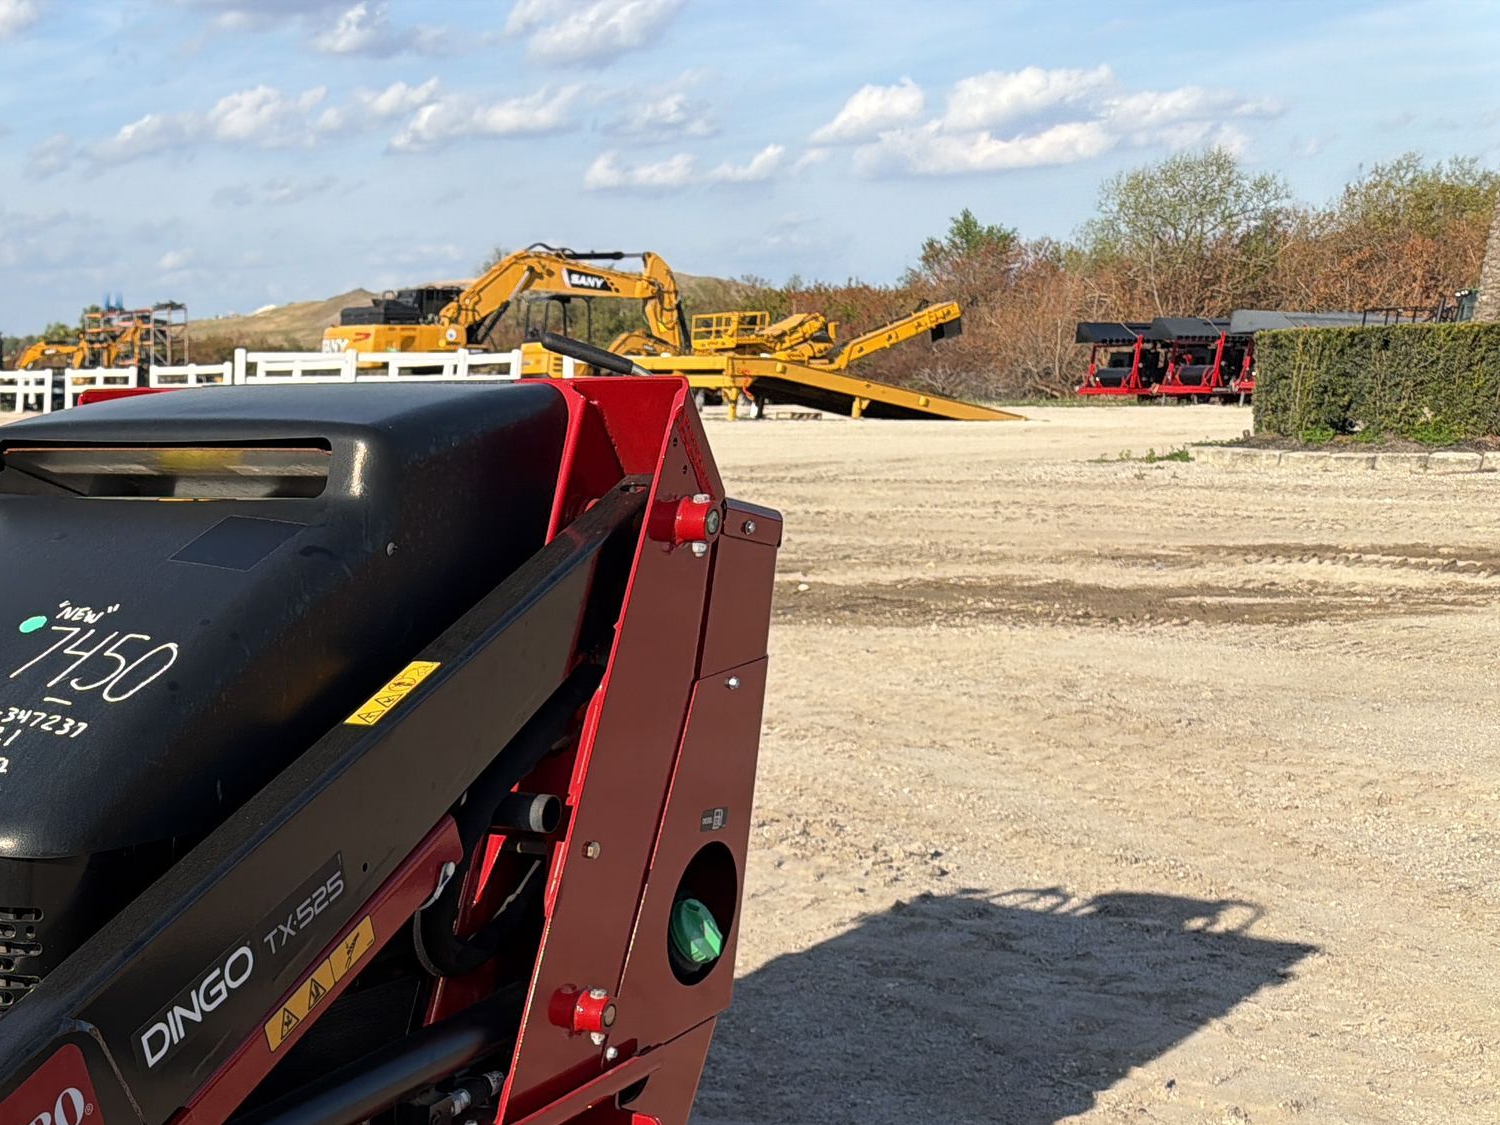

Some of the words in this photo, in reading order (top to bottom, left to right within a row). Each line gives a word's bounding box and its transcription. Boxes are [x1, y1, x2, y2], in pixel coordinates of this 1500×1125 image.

[570, 273, 604, 288] SANY
[9, 625, 179, 703] 7450
[140, 944, 254, 1069] DINGO
